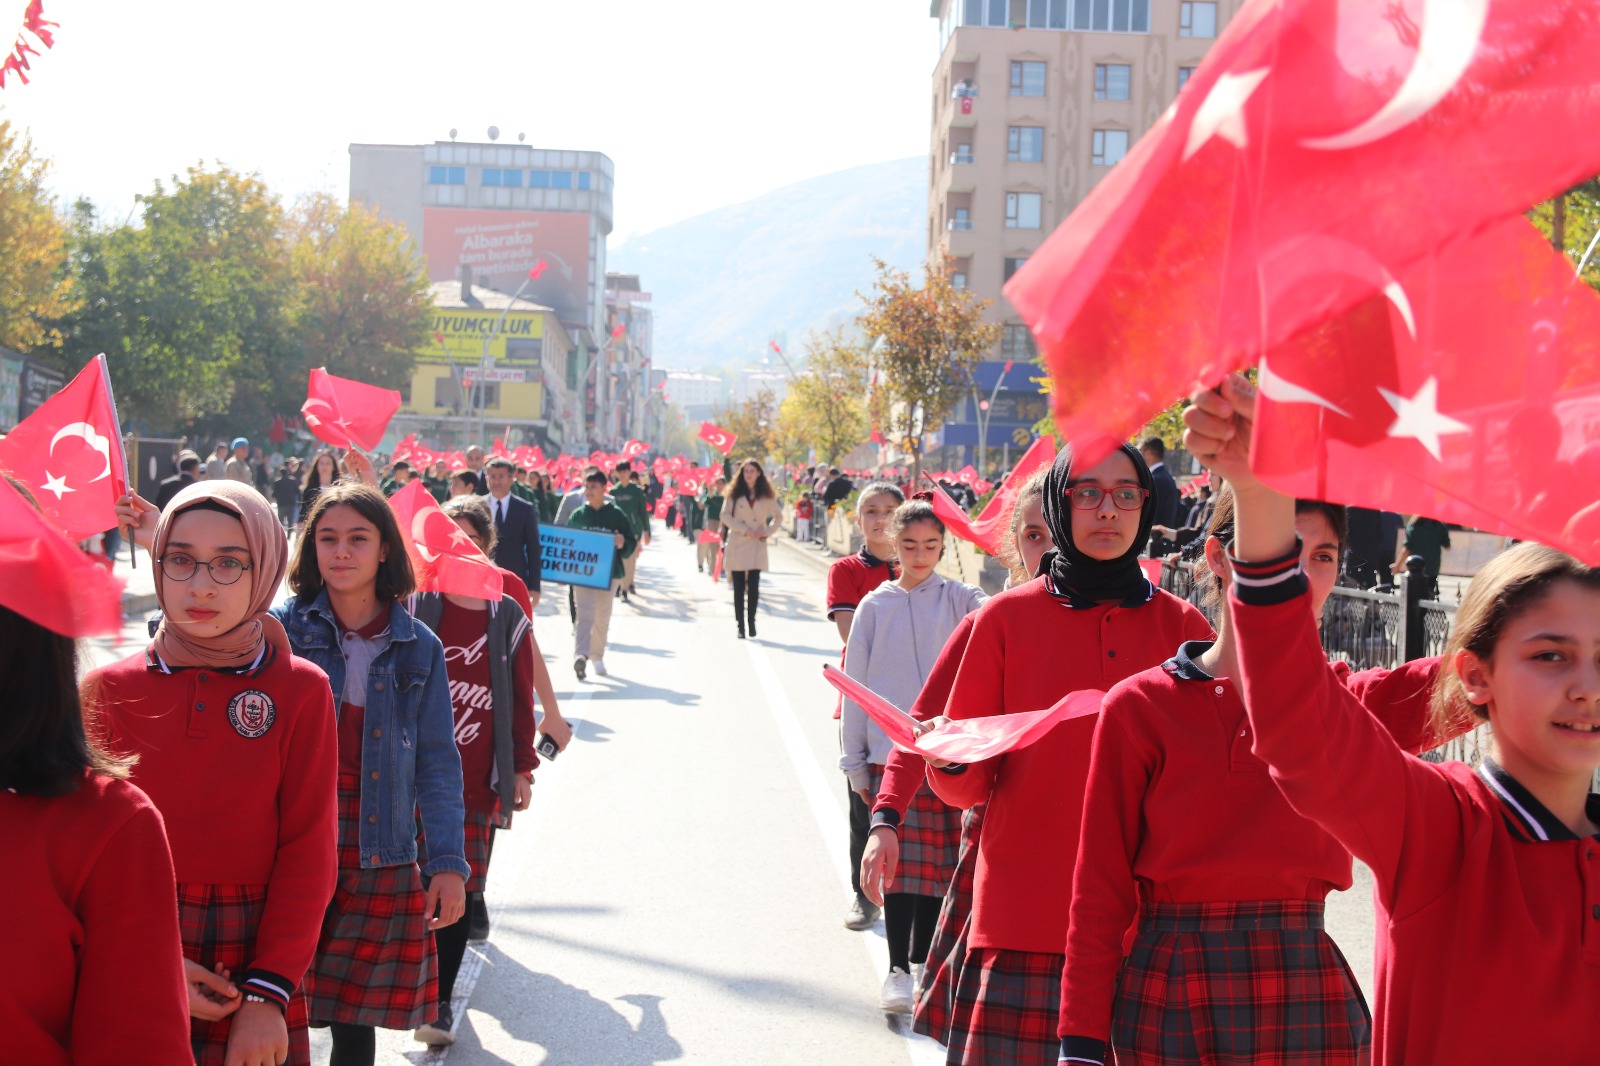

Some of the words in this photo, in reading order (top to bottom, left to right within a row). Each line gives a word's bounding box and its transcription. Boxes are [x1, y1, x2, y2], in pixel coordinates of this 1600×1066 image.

[462, 231, 534, 250] Albaraka
[459, 252, 486, 263] tam
[488, 246, 533, 261] burada
[432, 315, 533, 335] UYUMCULUK
[541, 533, 575, 547] ERKEZ
[540, 545, 599, 564] TELEKOM
